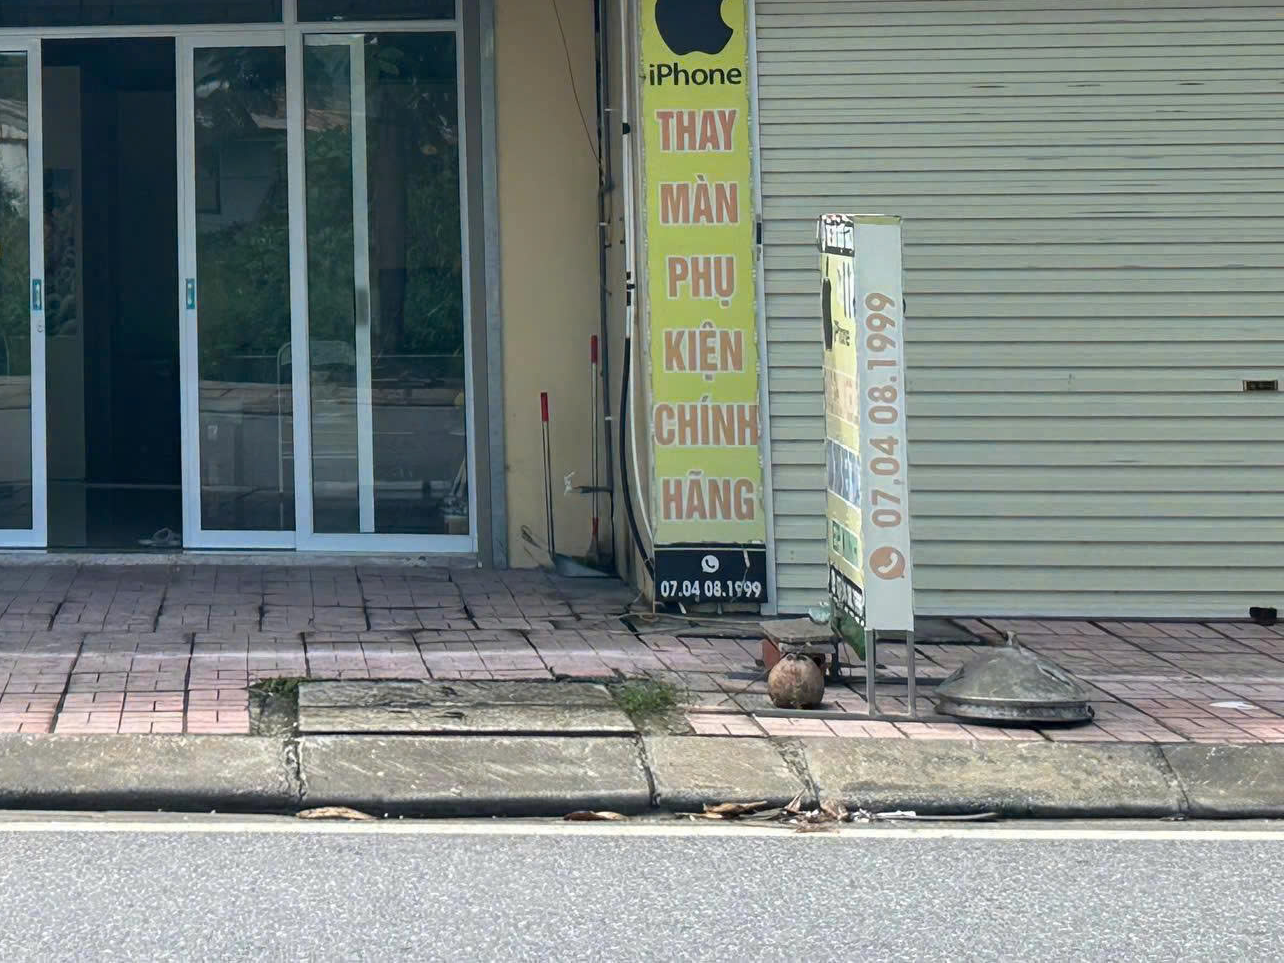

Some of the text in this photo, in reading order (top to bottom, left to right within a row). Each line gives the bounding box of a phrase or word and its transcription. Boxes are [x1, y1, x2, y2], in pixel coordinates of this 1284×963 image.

[649, 62, 742, 86] iPhone
[655, 110, 737, 151] THAY
[659, 174, 739, 224] MÀN
[668, 256, 735, 308] PHỤ
[663, 321, 744, 381] KIỆN
[865, 292, 899, 425] 08.1999
[654, 395, 760, 446] CHÍNH
[662, 470, 755, 521] HÃNG
[705, 581, 761, 597] 08.1999
